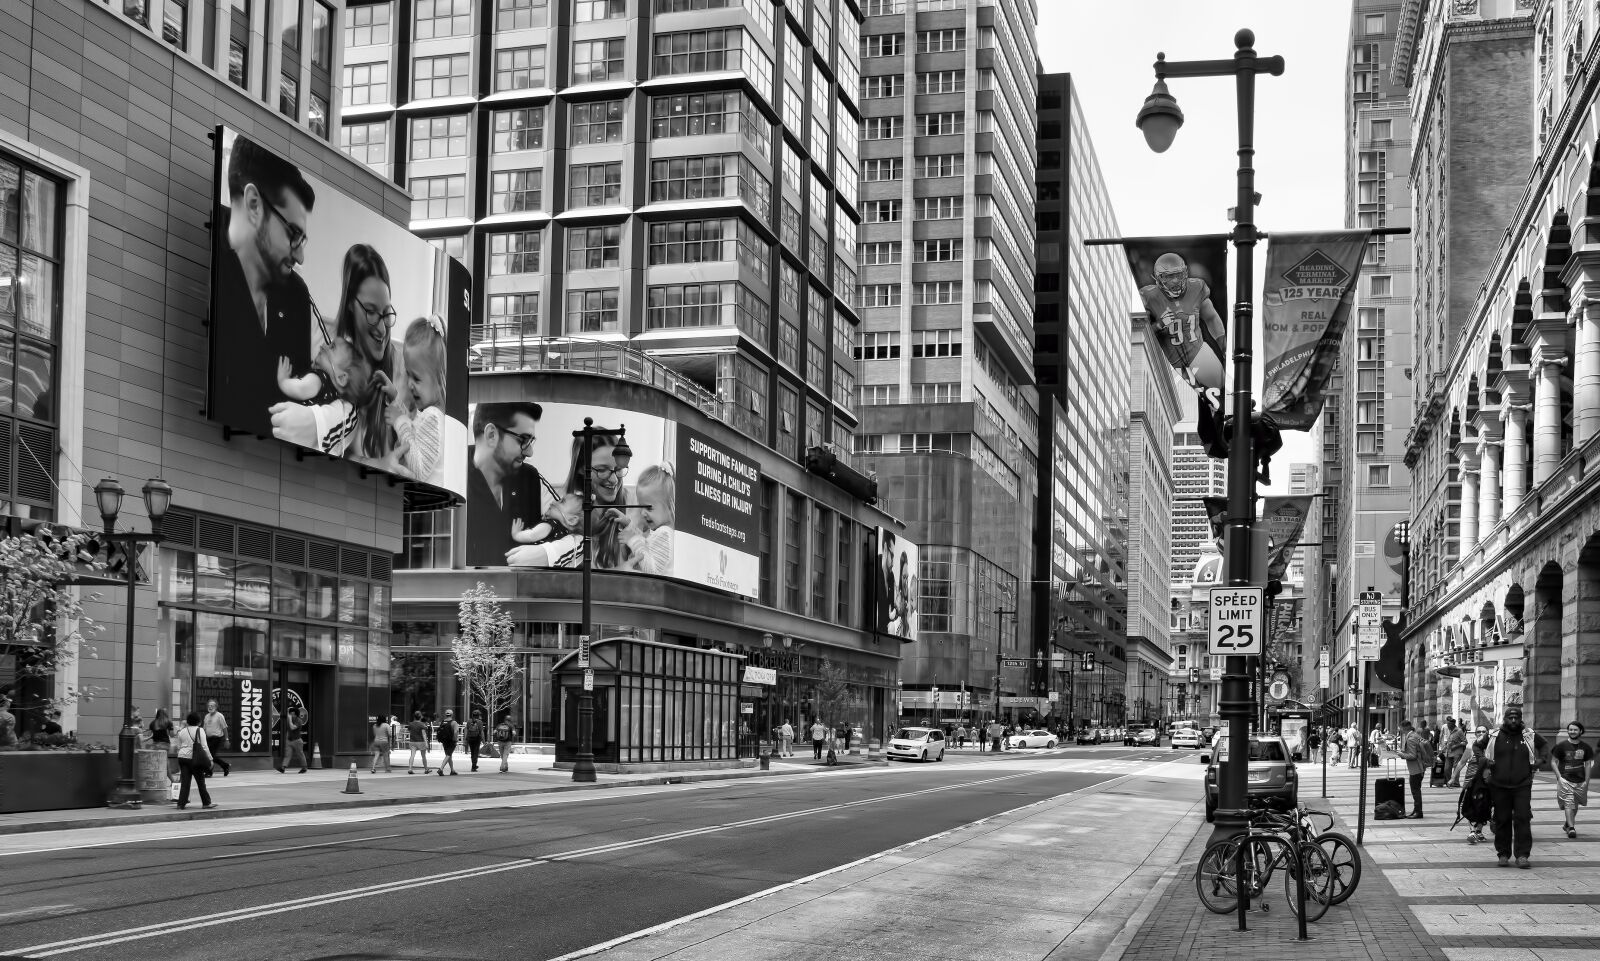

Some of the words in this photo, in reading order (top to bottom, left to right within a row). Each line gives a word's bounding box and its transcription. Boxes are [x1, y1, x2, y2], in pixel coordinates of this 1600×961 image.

[1284, 288, 1303, 298] 125
[1307, 287, 1345, 298] YEARS
[1264, 323, 1288, 332] MOM
[1291, 324, 1299, 332] &
[1303, 323, 1325, 332] POP
[1301, 311, 1327, 320] REAL
[1169, 314, 1198, 346] 91
[1268, 348, 1315, 378] PHILADELPHIA
[690, 437, 731, 469] SUPPORTING
[731, 457, 757, 482] FAMILIES
[697, 460, 722, 484] DURING
[722, 473, 728, 486] A
[728, 475, 751, 497] CHILD'S
[694, 479, 721, 503] ILLNESS
[721, 491, 731, 507] OR
[731, 495, 753, 516] INJURY
[701, 514, 746, 543] fredsfootsteps.org
[1214, 595, 1258, 606] SPEED
[1366, 592, 1375, 600] NO
[1218, 609, 1253, 620] LIMIT
[1217, 624, 1254, 648] 25
[197, 678, 233, 689] TACOS
[240, 679, 252, 753] COMING
[251, 687, 263, 745] SOON!
